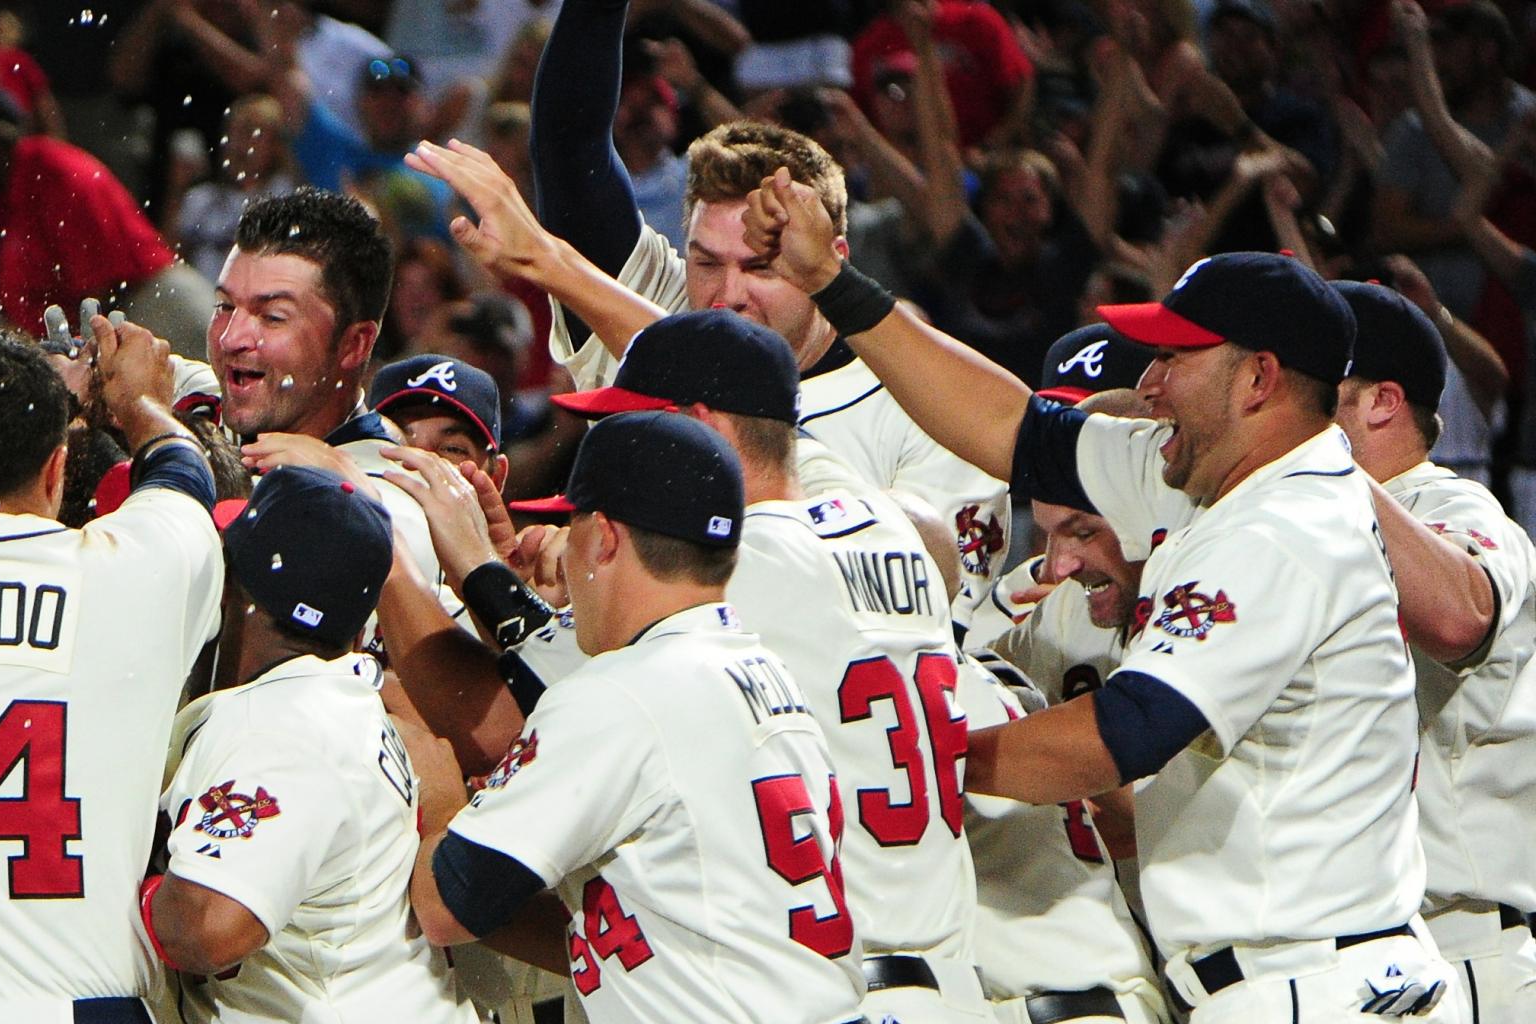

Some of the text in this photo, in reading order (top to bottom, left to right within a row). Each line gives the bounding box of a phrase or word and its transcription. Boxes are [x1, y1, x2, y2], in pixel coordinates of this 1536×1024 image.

[407, 361, 457, 392] A
[1057, 339, 1109, 378] A
[837, 653, 968, 848] 36
